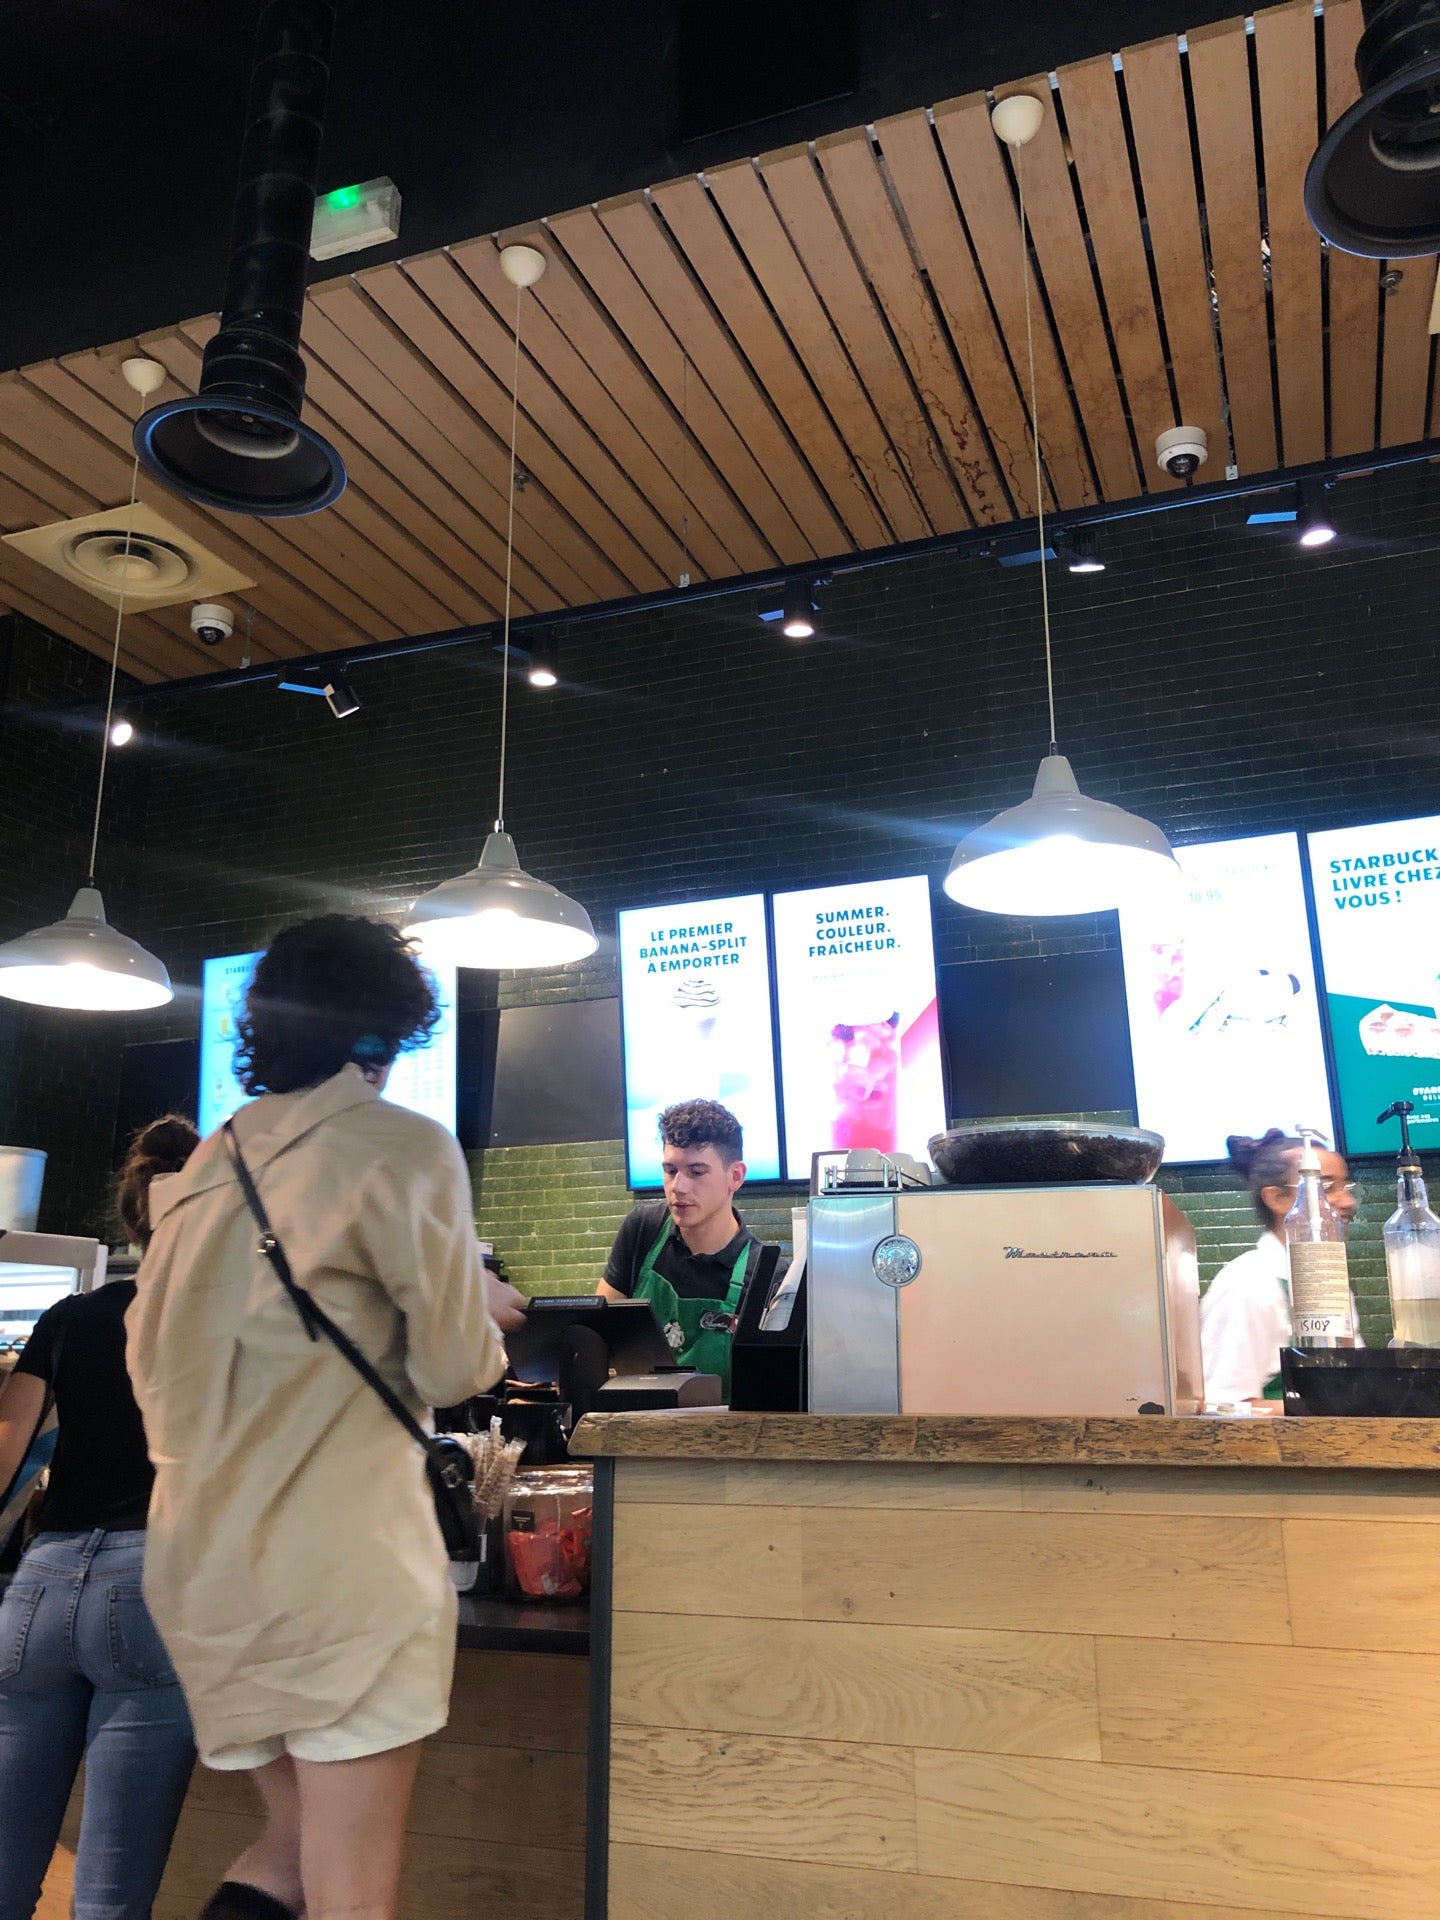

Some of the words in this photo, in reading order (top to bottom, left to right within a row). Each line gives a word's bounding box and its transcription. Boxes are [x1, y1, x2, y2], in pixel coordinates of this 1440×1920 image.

[815, 905, 890, 925] SUMMER.
[651, 930, 665, 942] LE
[669, 922, 734, 940] PREMIER
[816, 922, 892, 941] COULEUR.
[640, 936, 748, 959] BANANA-SPLIT
[808, 937, 901, 958] FRAÎCHEUR.
[665, 953, 740, 972] EMPORTER
